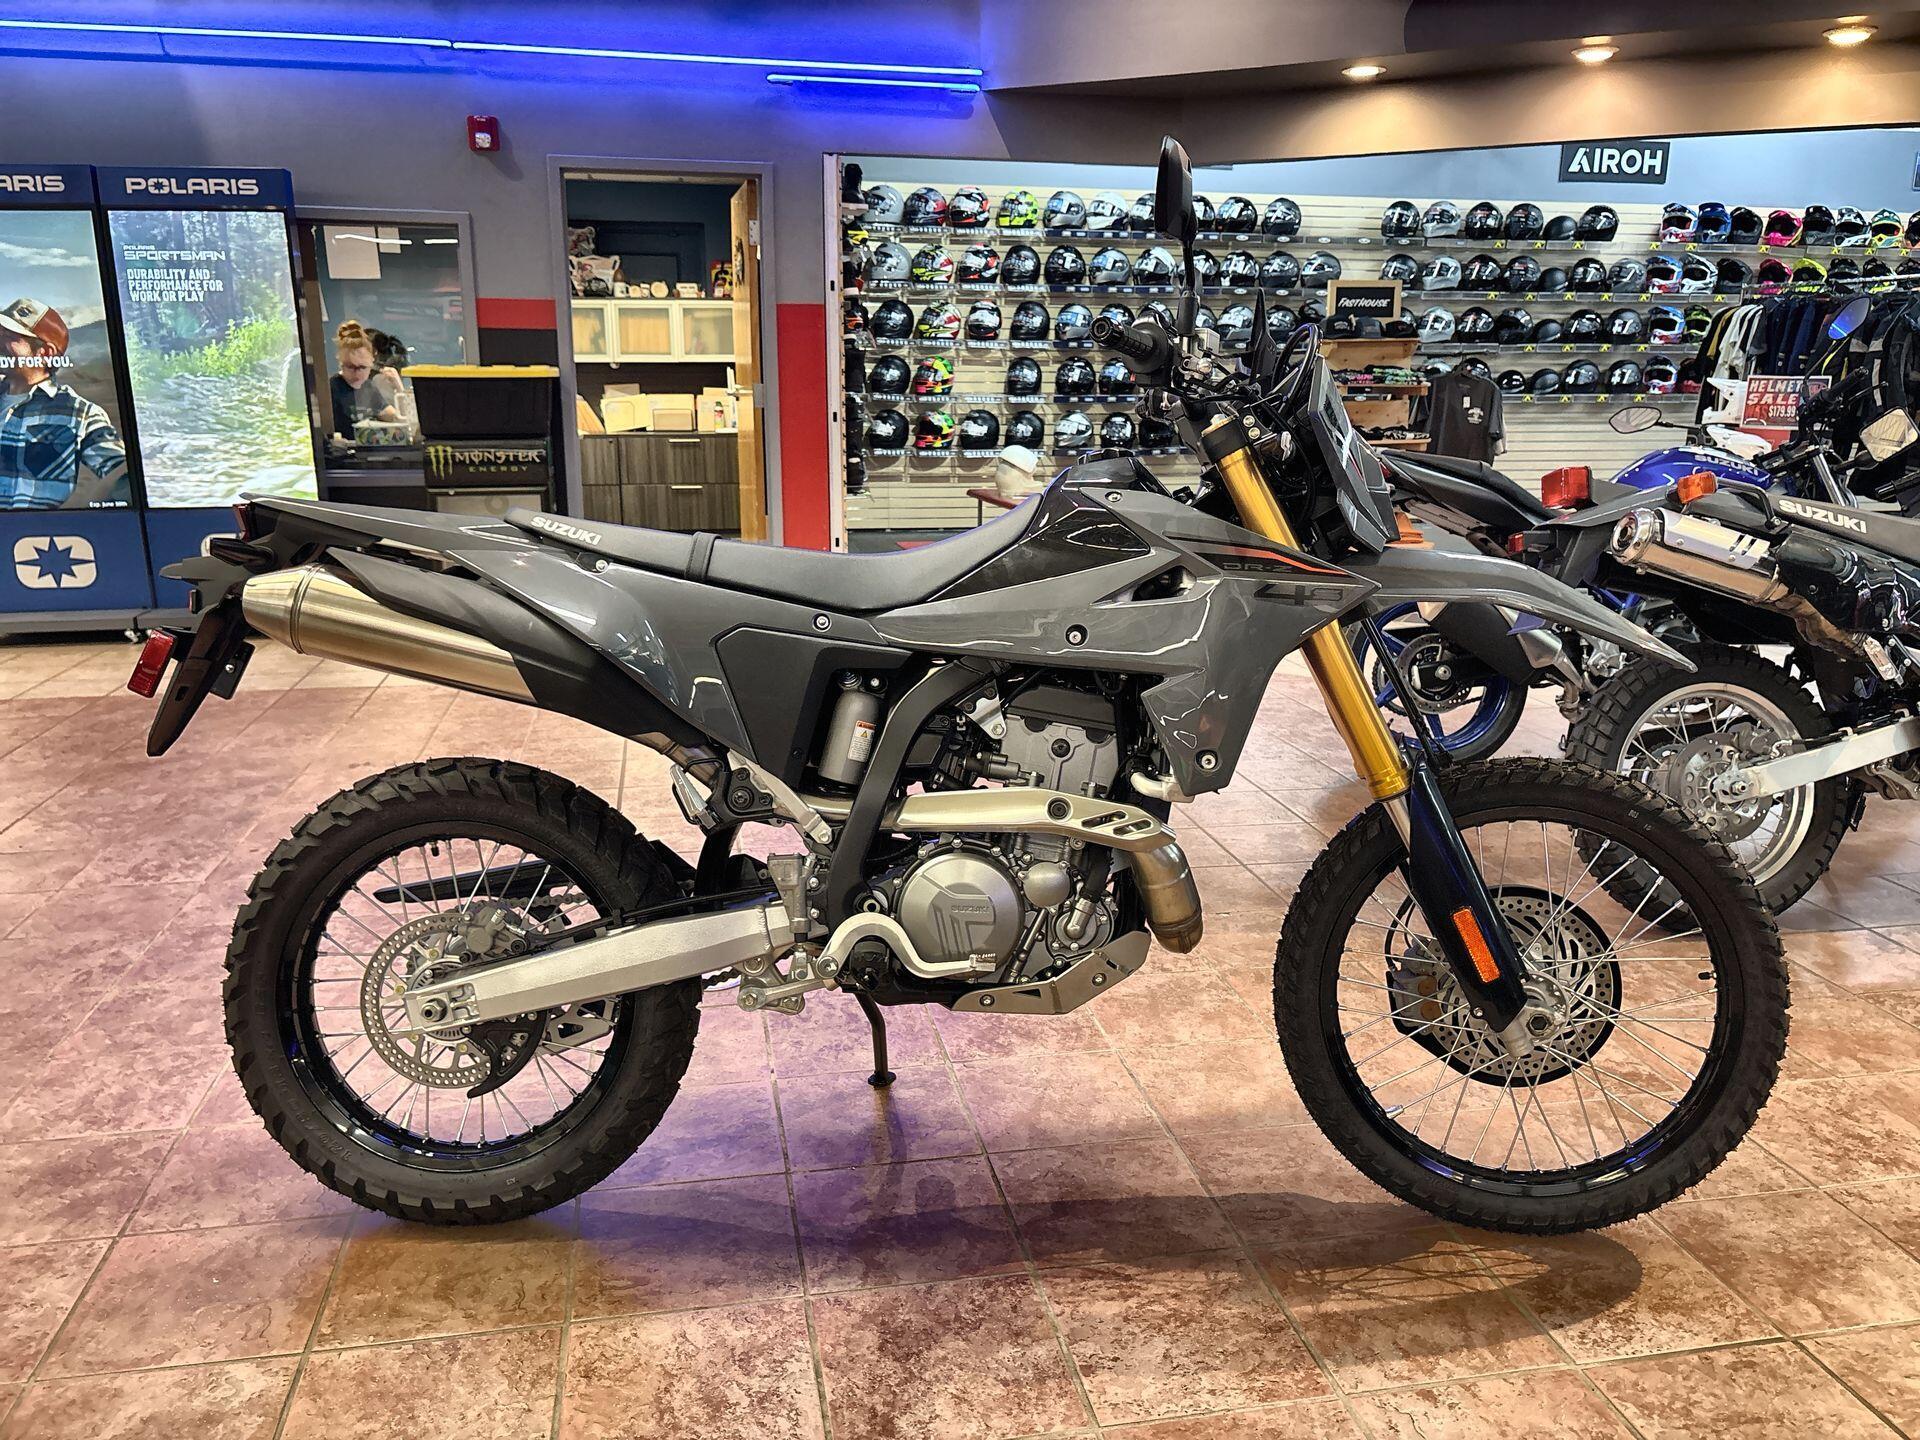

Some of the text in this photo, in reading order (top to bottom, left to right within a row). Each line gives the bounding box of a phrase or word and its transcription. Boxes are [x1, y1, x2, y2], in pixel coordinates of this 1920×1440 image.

[1567, 147, 1663, 175] AIROH
[0, 174, 65, 192] ARIS
[125, 177, 260, 195] POLARIS
[123, 250, 226, 261] SPORTSMAN
[126, 268, 211, 280] DURABILITY AND
[128, 280, 224, 292] PERFORMANCE FOR
[130, 291, 205, 302] WORK OR PLAY
[1337, 297, 1391, 308] FASTHOUSE
[19, 356, 44, 369] FOR
[45, 355, 74, 368] YOU.
[1748, 379, 1804, 393] HELMET
[1746, 393, 1799, 406] SALE
[1768, 405, 1797, 418] $179.99
[455, 449, 541, 465] MONSTER
[468, 465, 529, 473] ENERGY
[1694, 454, 1759, 477] SUZUKI
[1778, 499, 1868, 534] SUZUKI
[530, 516, 602, 545] SUZUKI
[1222, 561, 1294, 573] DR-Z
[951, 904, 991, 914] SUZUKI
